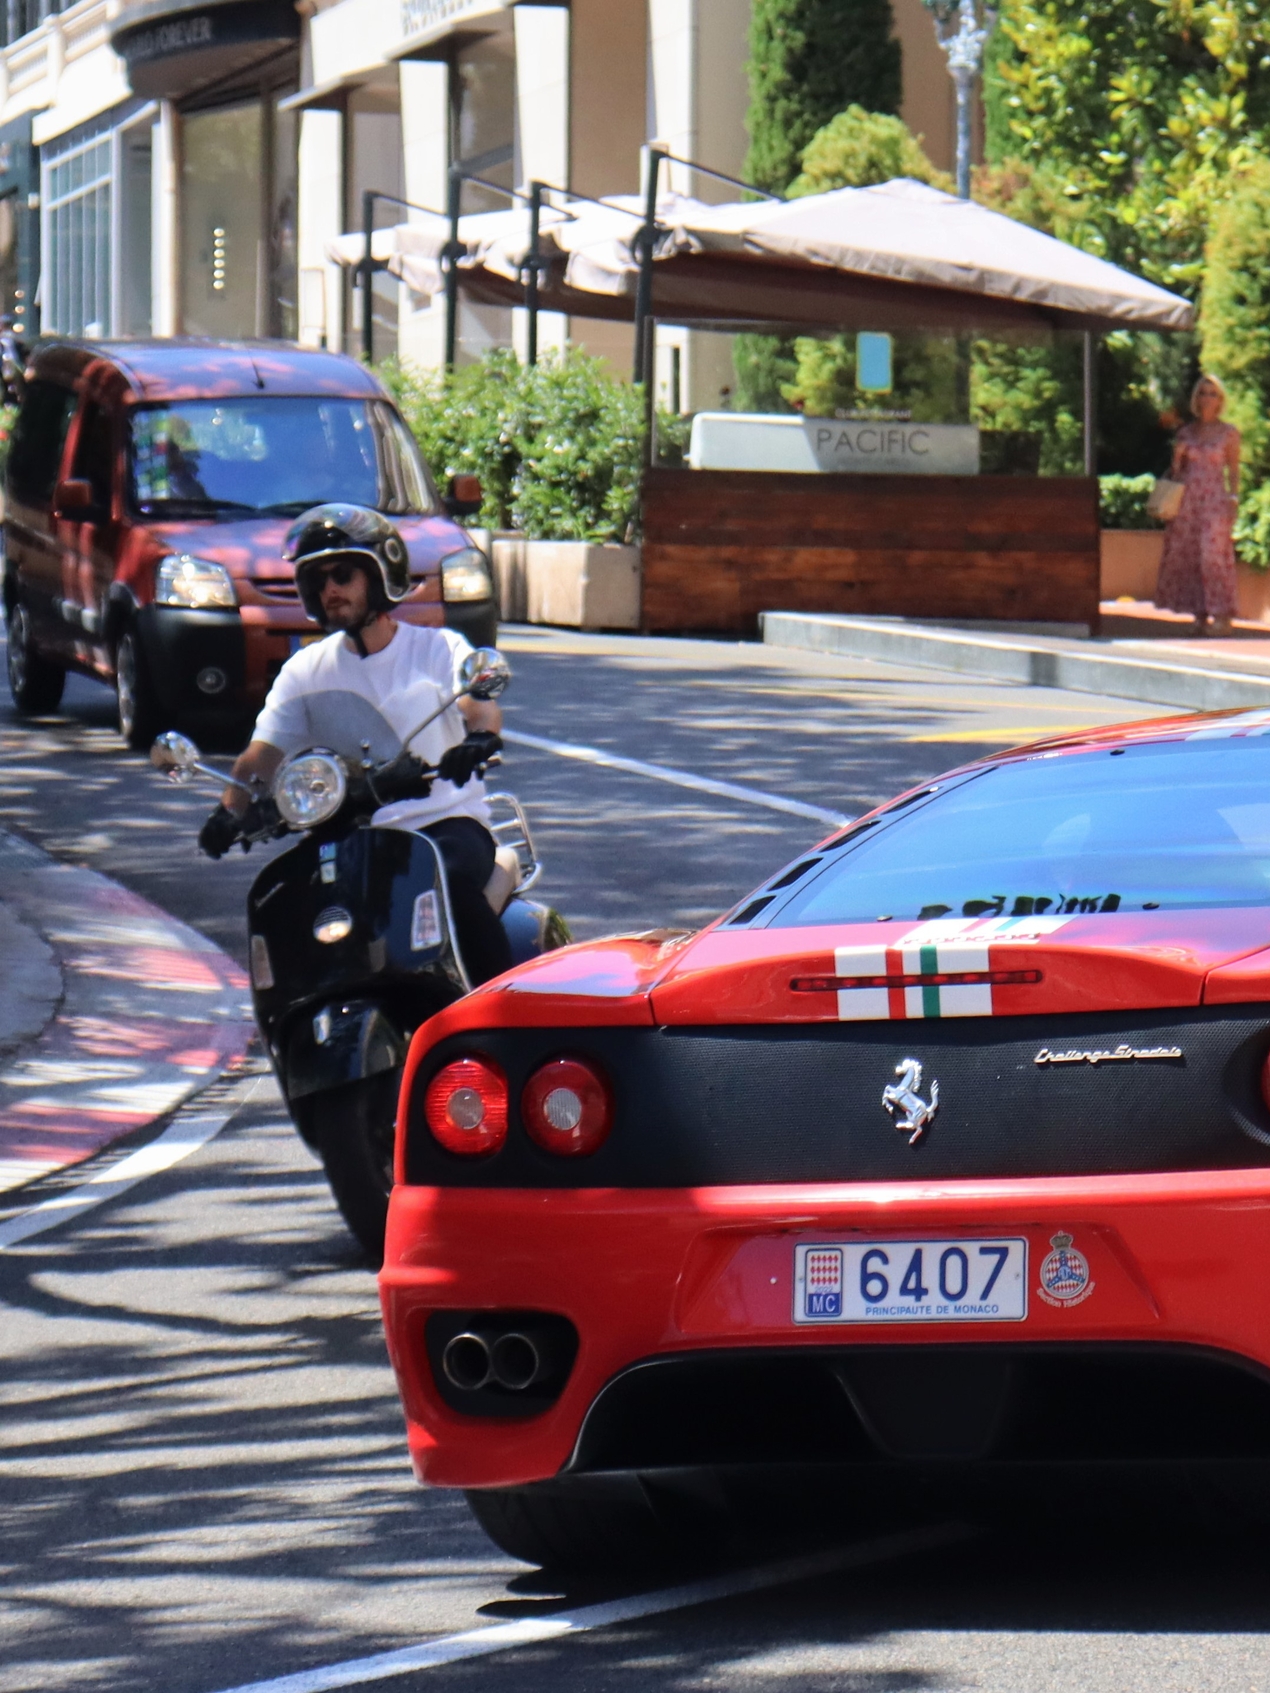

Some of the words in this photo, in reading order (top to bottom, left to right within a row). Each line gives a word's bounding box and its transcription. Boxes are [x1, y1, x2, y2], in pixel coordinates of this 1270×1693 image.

[816, 428, 930, 456] PACIFIC
[1034, 1048, 1111, 1064] Challenge
[1112, 1044, 1182, 1059] Stradale
[860, 1246, 1009, 1304] 6407
[811, 1294, 836, 1313] MC
[865, 1305, 932, 1316] PRINCIPAUTE
[936, 1305, 949, 1314] DE
[953, 1304, 999, 1314] MONACO
